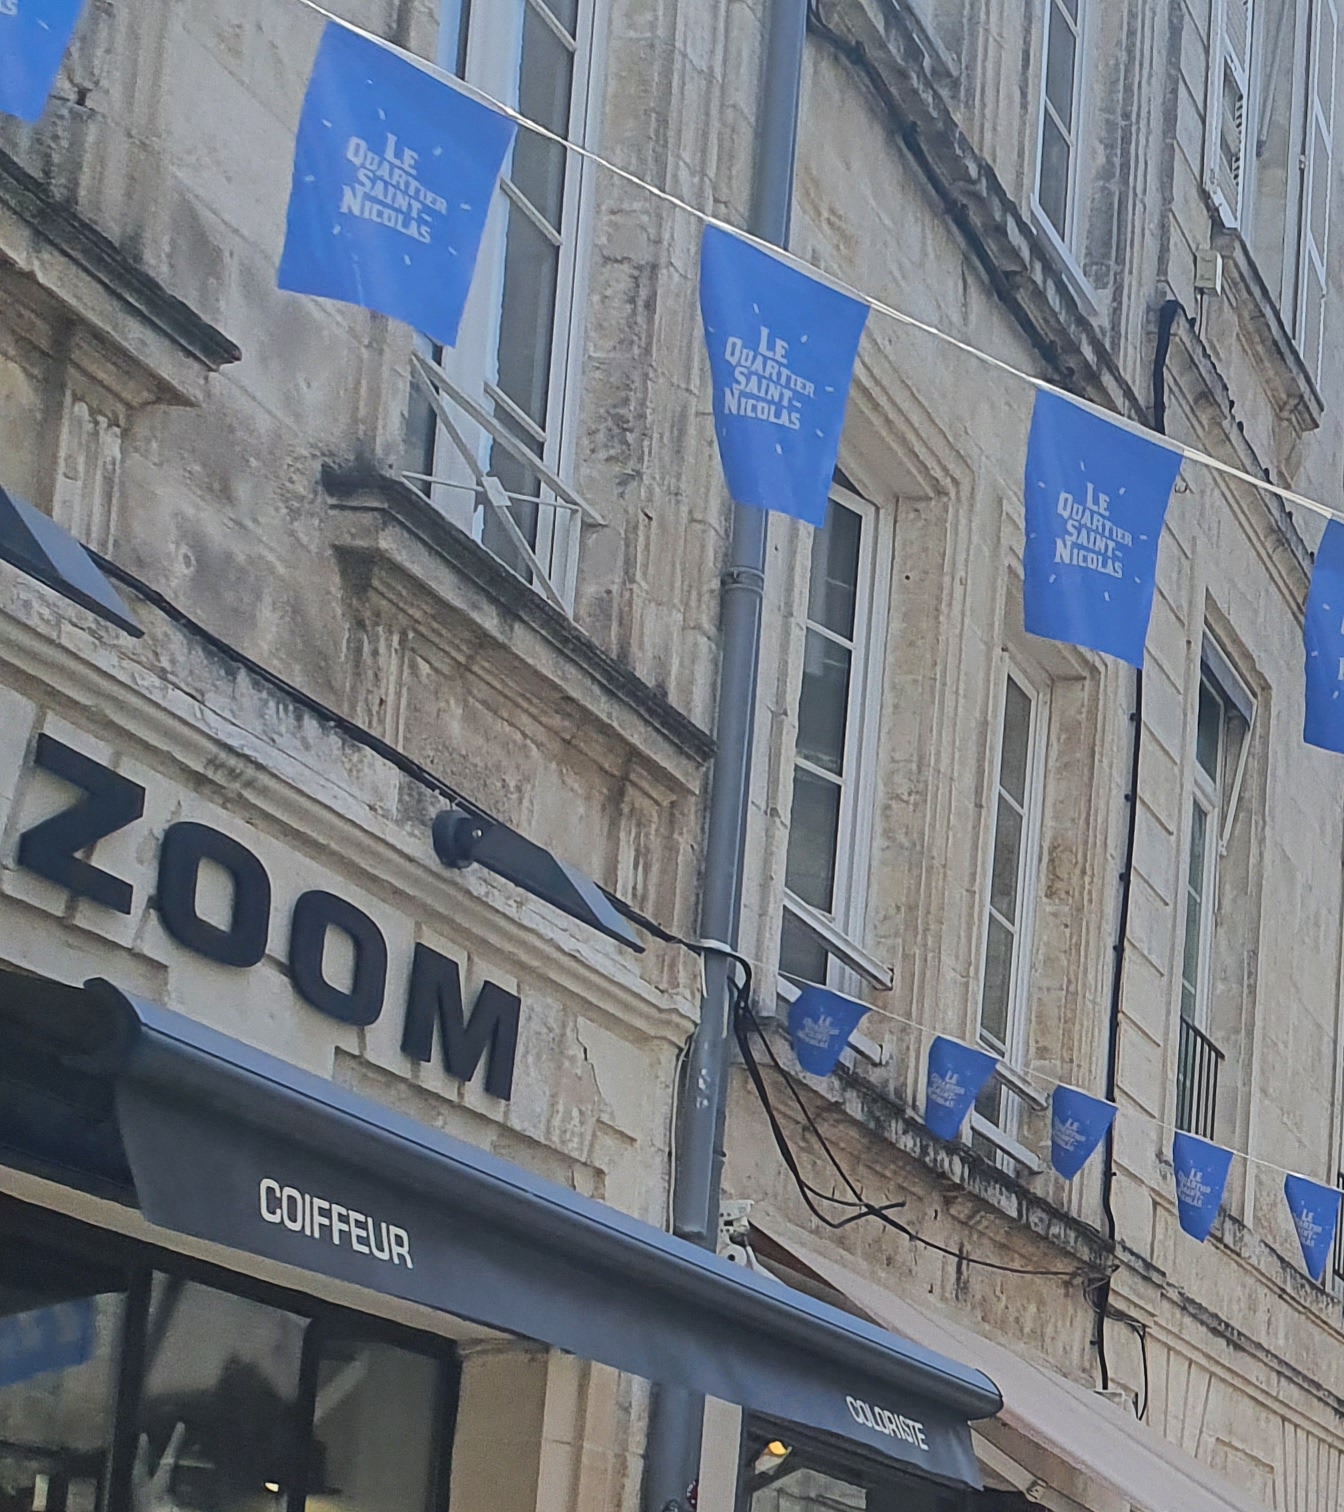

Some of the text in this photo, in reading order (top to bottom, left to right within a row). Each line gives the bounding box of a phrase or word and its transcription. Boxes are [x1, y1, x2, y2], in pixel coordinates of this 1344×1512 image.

[19, 732, 521, 1101] ZOOM
[259, 1178, 413, 1269] COIFFEUR
[846, 1395, 929, 1450] COLORISTE
